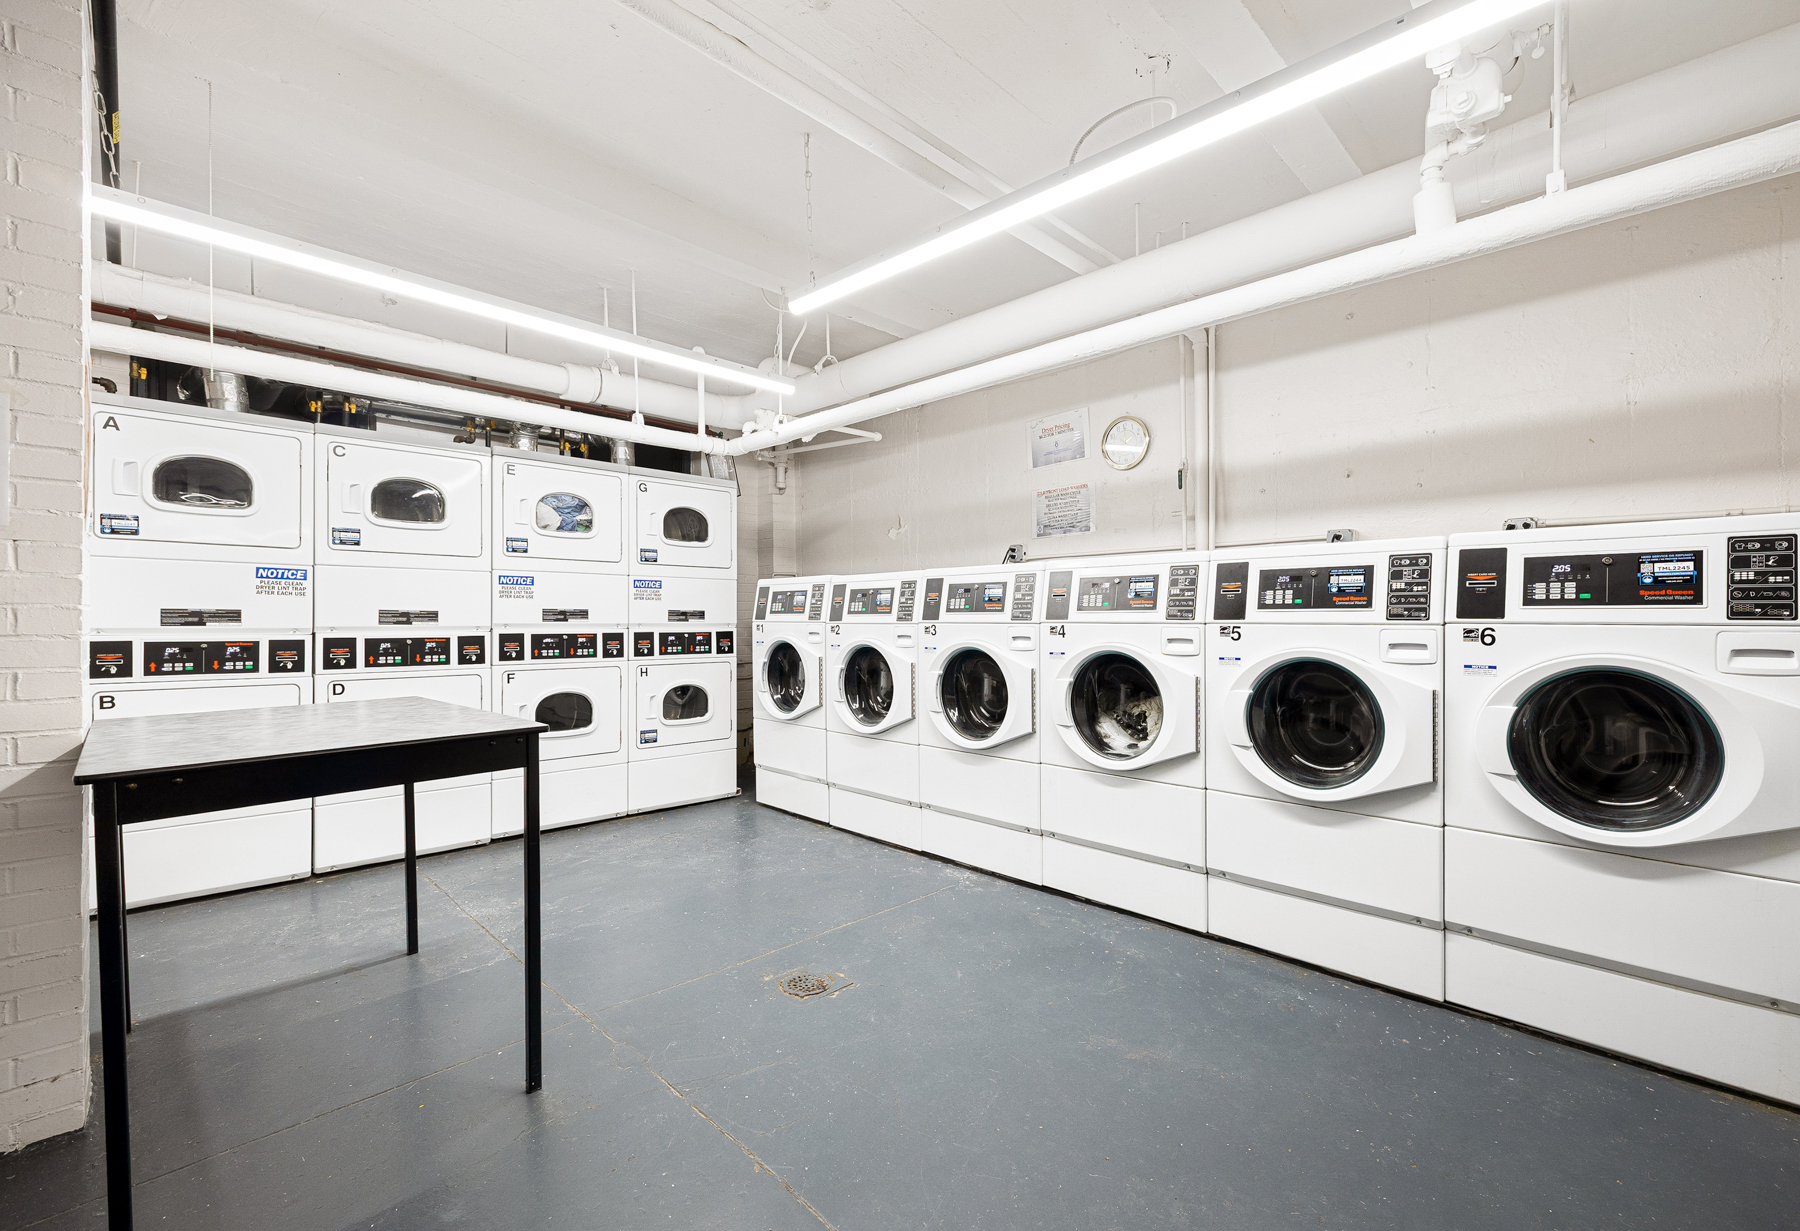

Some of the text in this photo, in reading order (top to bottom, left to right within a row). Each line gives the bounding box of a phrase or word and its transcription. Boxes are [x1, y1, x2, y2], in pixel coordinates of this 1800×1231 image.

[103, 416, 120, 431] A
[332, 445, 347, 457] C
[507, 464, 516, 476] E
[639, 483, 648, 493] G
[257, 568, 306, 579] NOTICE
[500, 576, 533, 585] NOTICE
[634, 580, 661, 588] NOTICE
[760, 624, 764, 633] 1
[835, 624, 841, 635] 2
[931, 624, 937, 636] 3
[1058, 625, 1066, 638] 4
[1231, 625, 1242, 641] 5
[1480, 627, 1496, 646] 6
[640, 667, 648, 677] H
[507, 673, 516, 684] F
[332, 683, 346, 696] D
[99, 695, 116, 710] B
